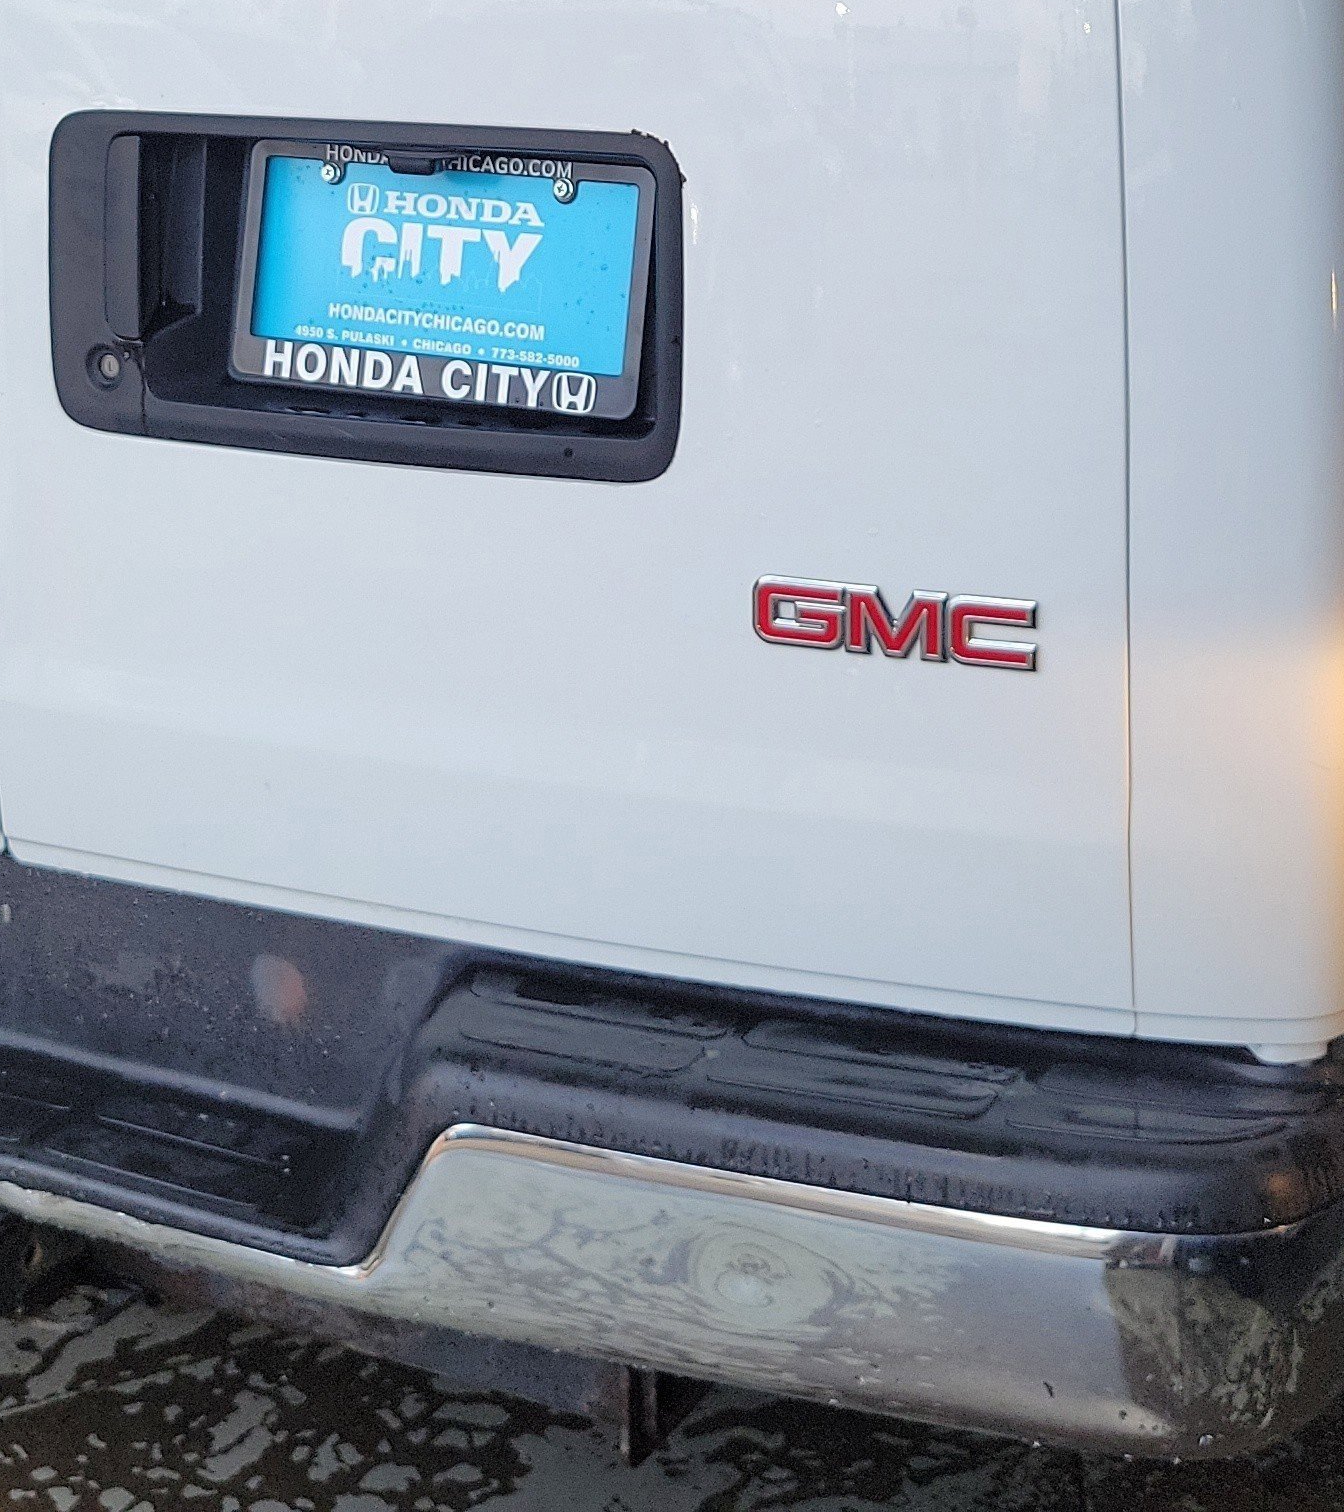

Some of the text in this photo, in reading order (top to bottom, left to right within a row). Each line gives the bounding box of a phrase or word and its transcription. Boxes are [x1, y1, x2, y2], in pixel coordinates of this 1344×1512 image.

[326, 143, 573, 178] HONDHICAGO.COM
[382, 190, 545, 227] HONDA
[341, 216, 544, 293] CITY
[328, 302, 545, 340] HONDACITYCHICAGO.COM
[296, 324, 580, 367] 4950 S. PULASKI CHICAGO 773-582-5000
[262, 339, 425, 395] HONDA
[441, 359, 552, 407] CITY
[752, 573, 1037, 671] GMC
